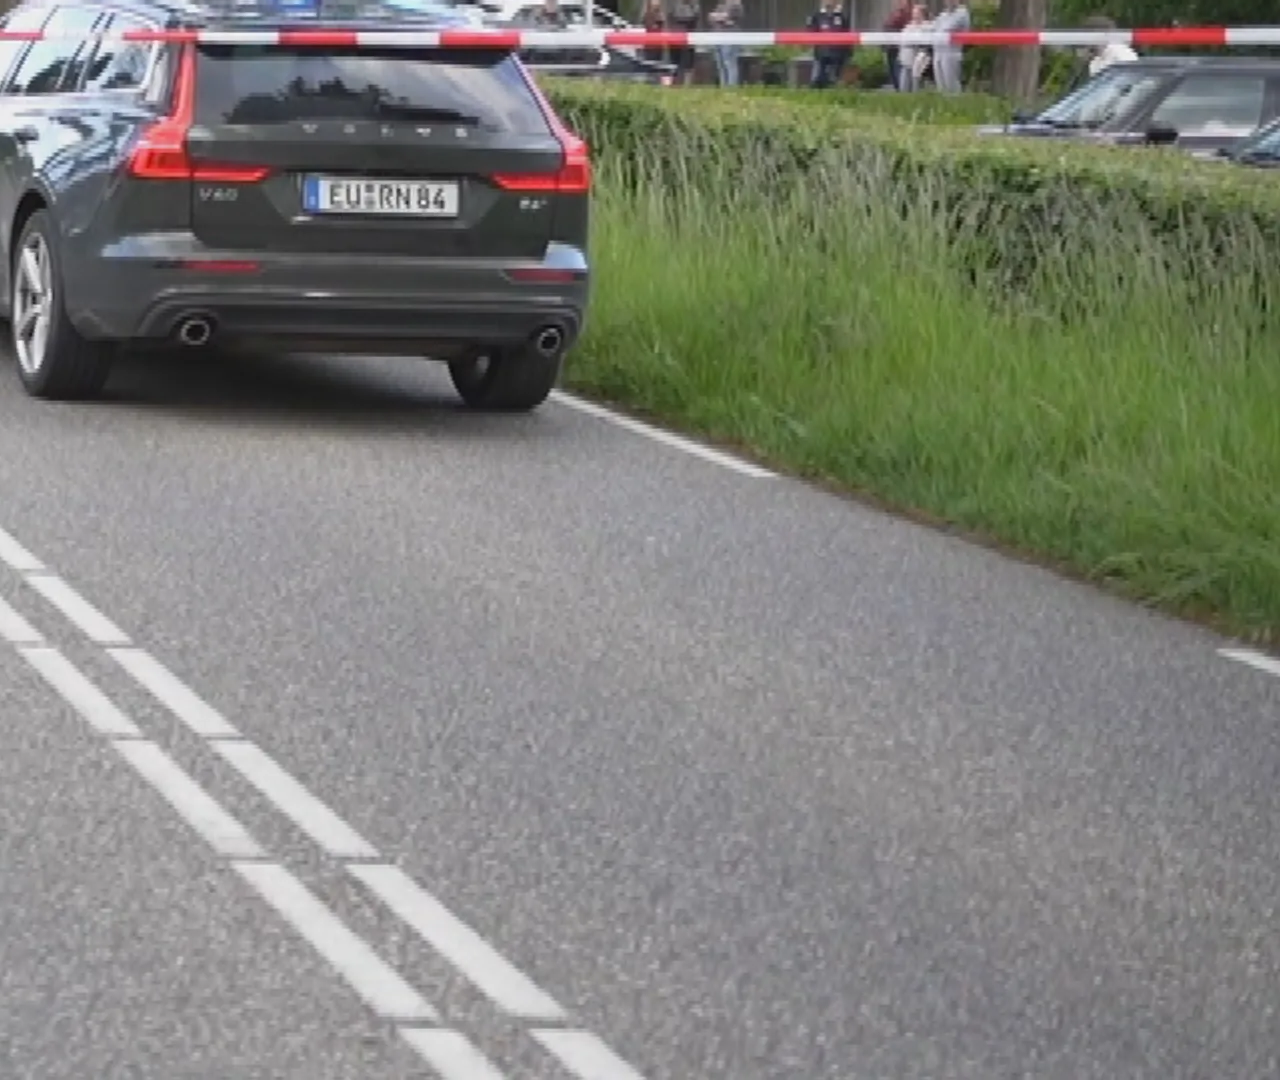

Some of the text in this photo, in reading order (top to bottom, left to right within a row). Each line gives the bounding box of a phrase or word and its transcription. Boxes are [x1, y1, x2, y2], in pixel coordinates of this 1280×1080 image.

[329, 183, 446, 210] EU RN 84
